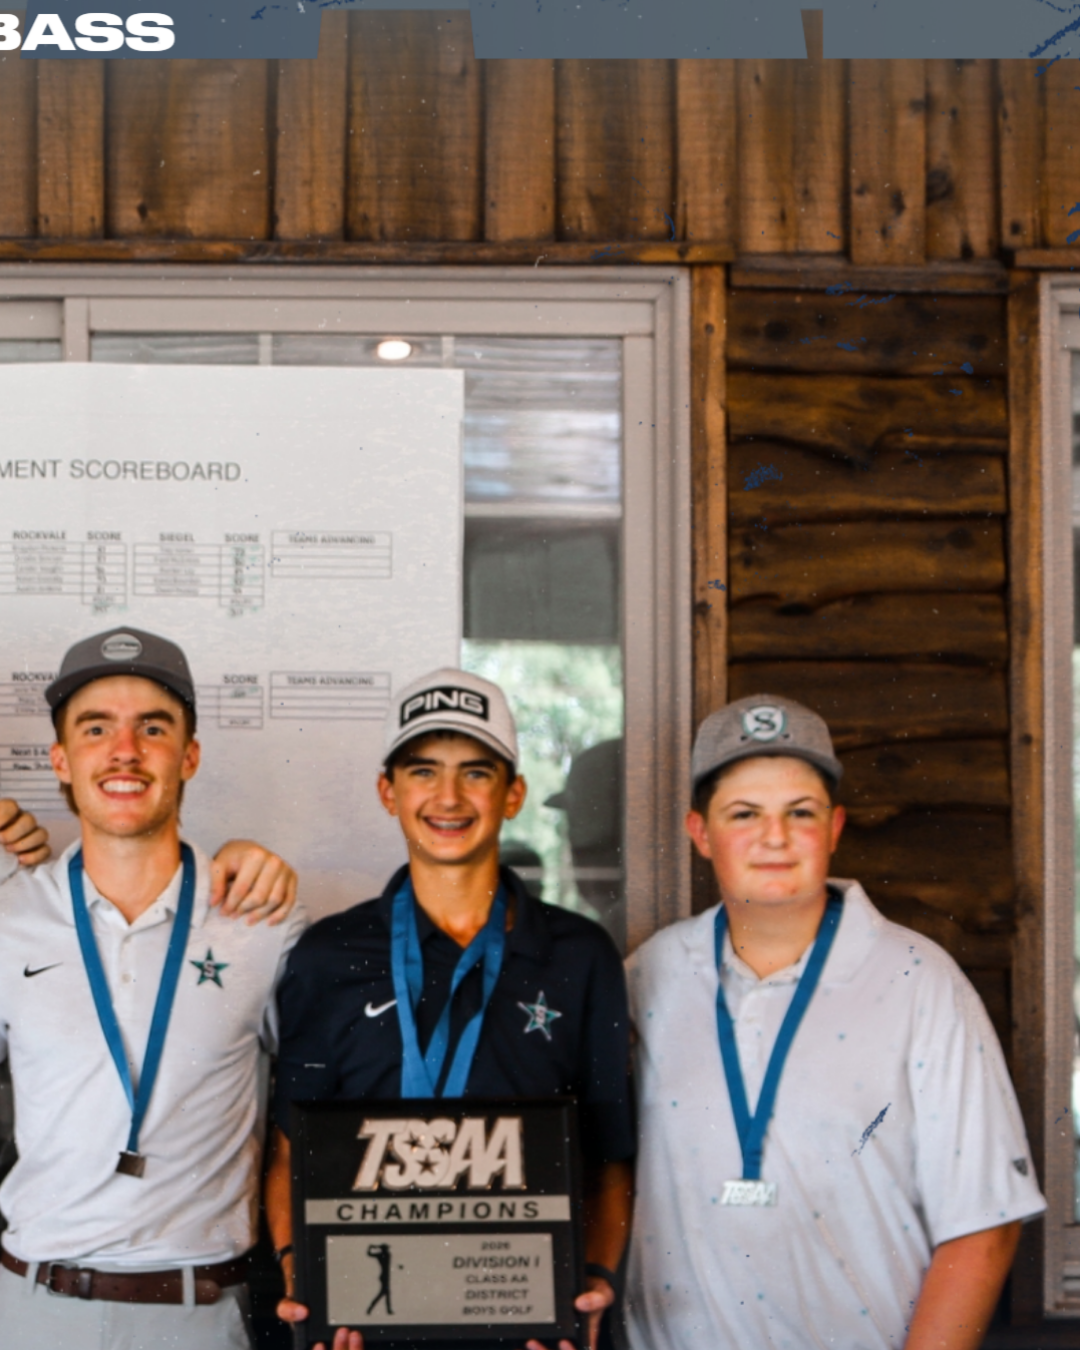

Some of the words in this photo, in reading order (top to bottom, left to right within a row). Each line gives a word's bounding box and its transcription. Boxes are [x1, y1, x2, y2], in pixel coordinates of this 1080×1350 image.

[69, 459, 242, 482] SCOREBOARD
[12, 531, 67, 540] ROCKVALE
[86, 531, 122, 540] SCORE
[159, 533, 195, 542] SIEGEL
[224, 533, 260, 543] SCORE
[12, 671, 59, 682] ROCKVA
[223, 674, 259, 685] SCORE
[403, 689, 484, 721] PING
[753, 710, 777, 733] S
[203, 959, 216, 978] S
[352, 1117, 528, 1192] TSSAA
[336, 1201, 540, 1222] CHAMPIONS
[452, 1256, 530, 1269] DIVISION
[465, 1274, 508, 1284] CLASS
[510, 1274, 529, 1284] AA
[465, 1289, 529, 1300] DISTRICT
[462, 1306, 497, 1316] BOYS
[501, 1305, 533, 1316] GOLF
